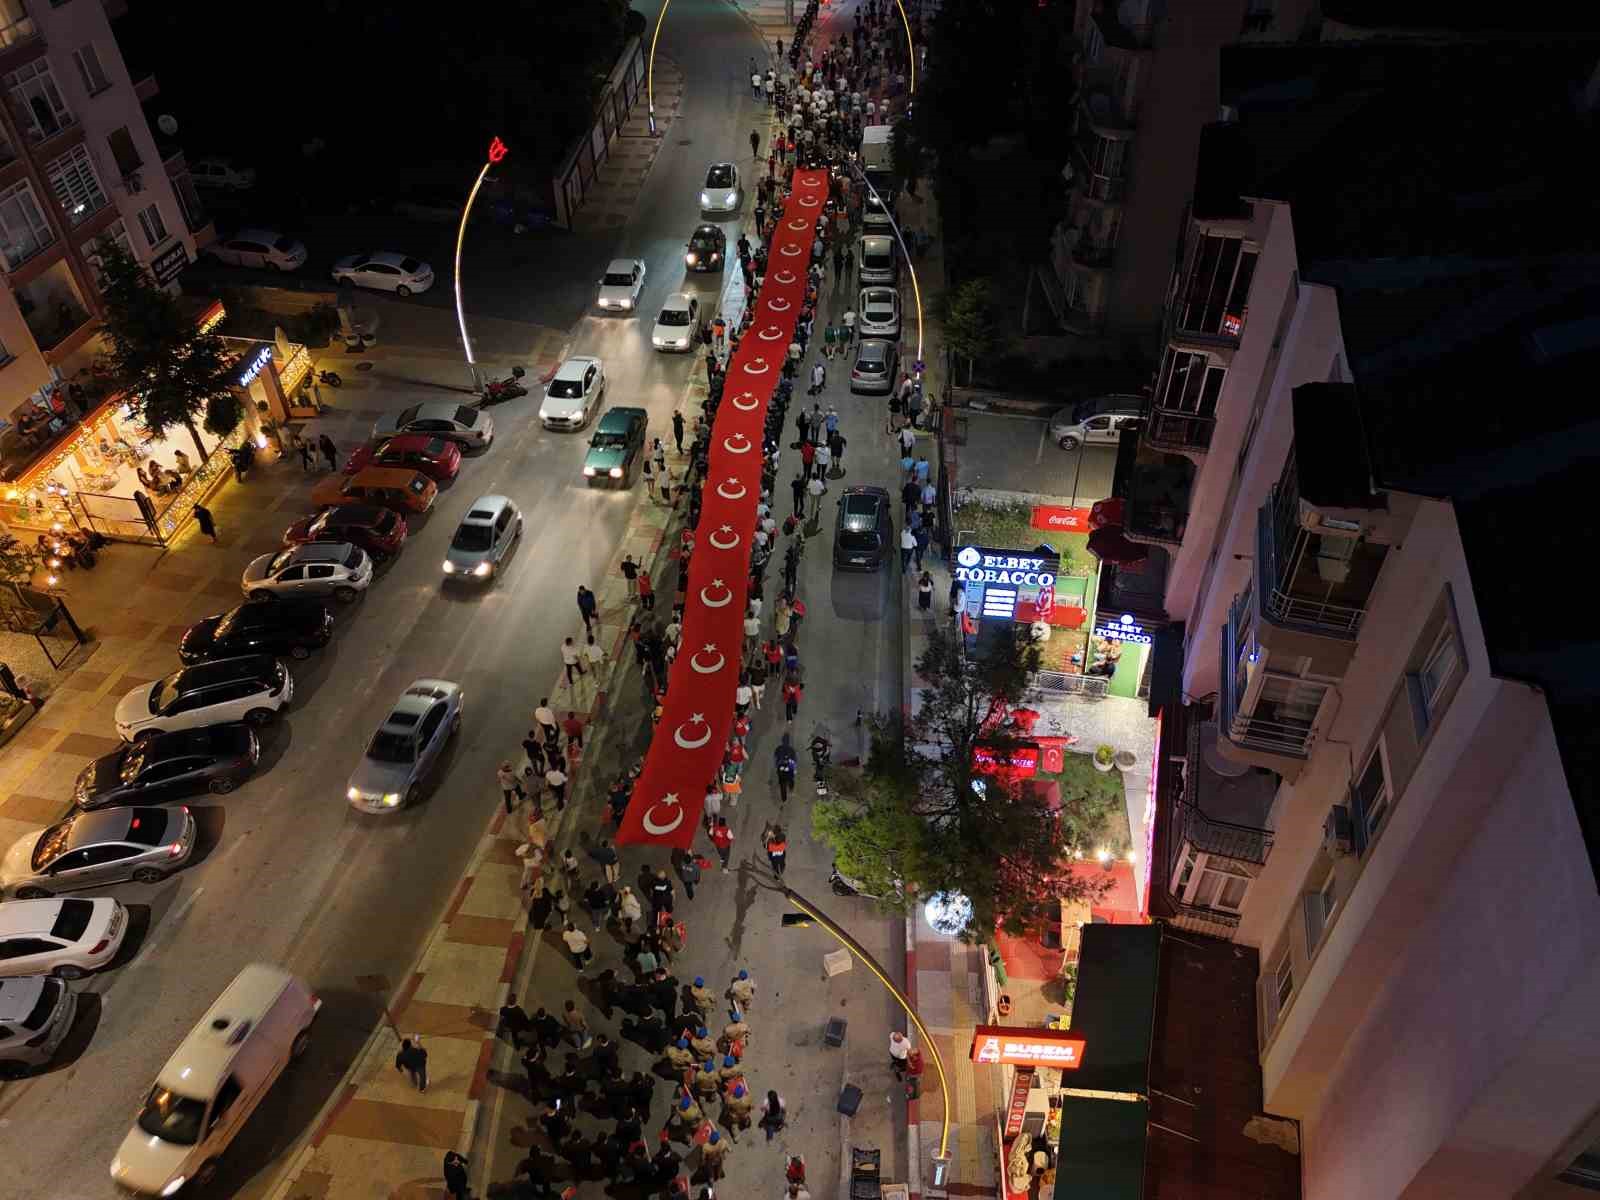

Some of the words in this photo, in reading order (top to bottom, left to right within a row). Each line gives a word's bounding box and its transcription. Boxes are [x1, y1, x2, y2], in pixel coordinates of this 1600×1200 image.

[983, 555, 1044, 570] ELBEY
[955, 567, 1054, 586] TOBACCO
[1095, 628, 1152, 643] TOBACCO
